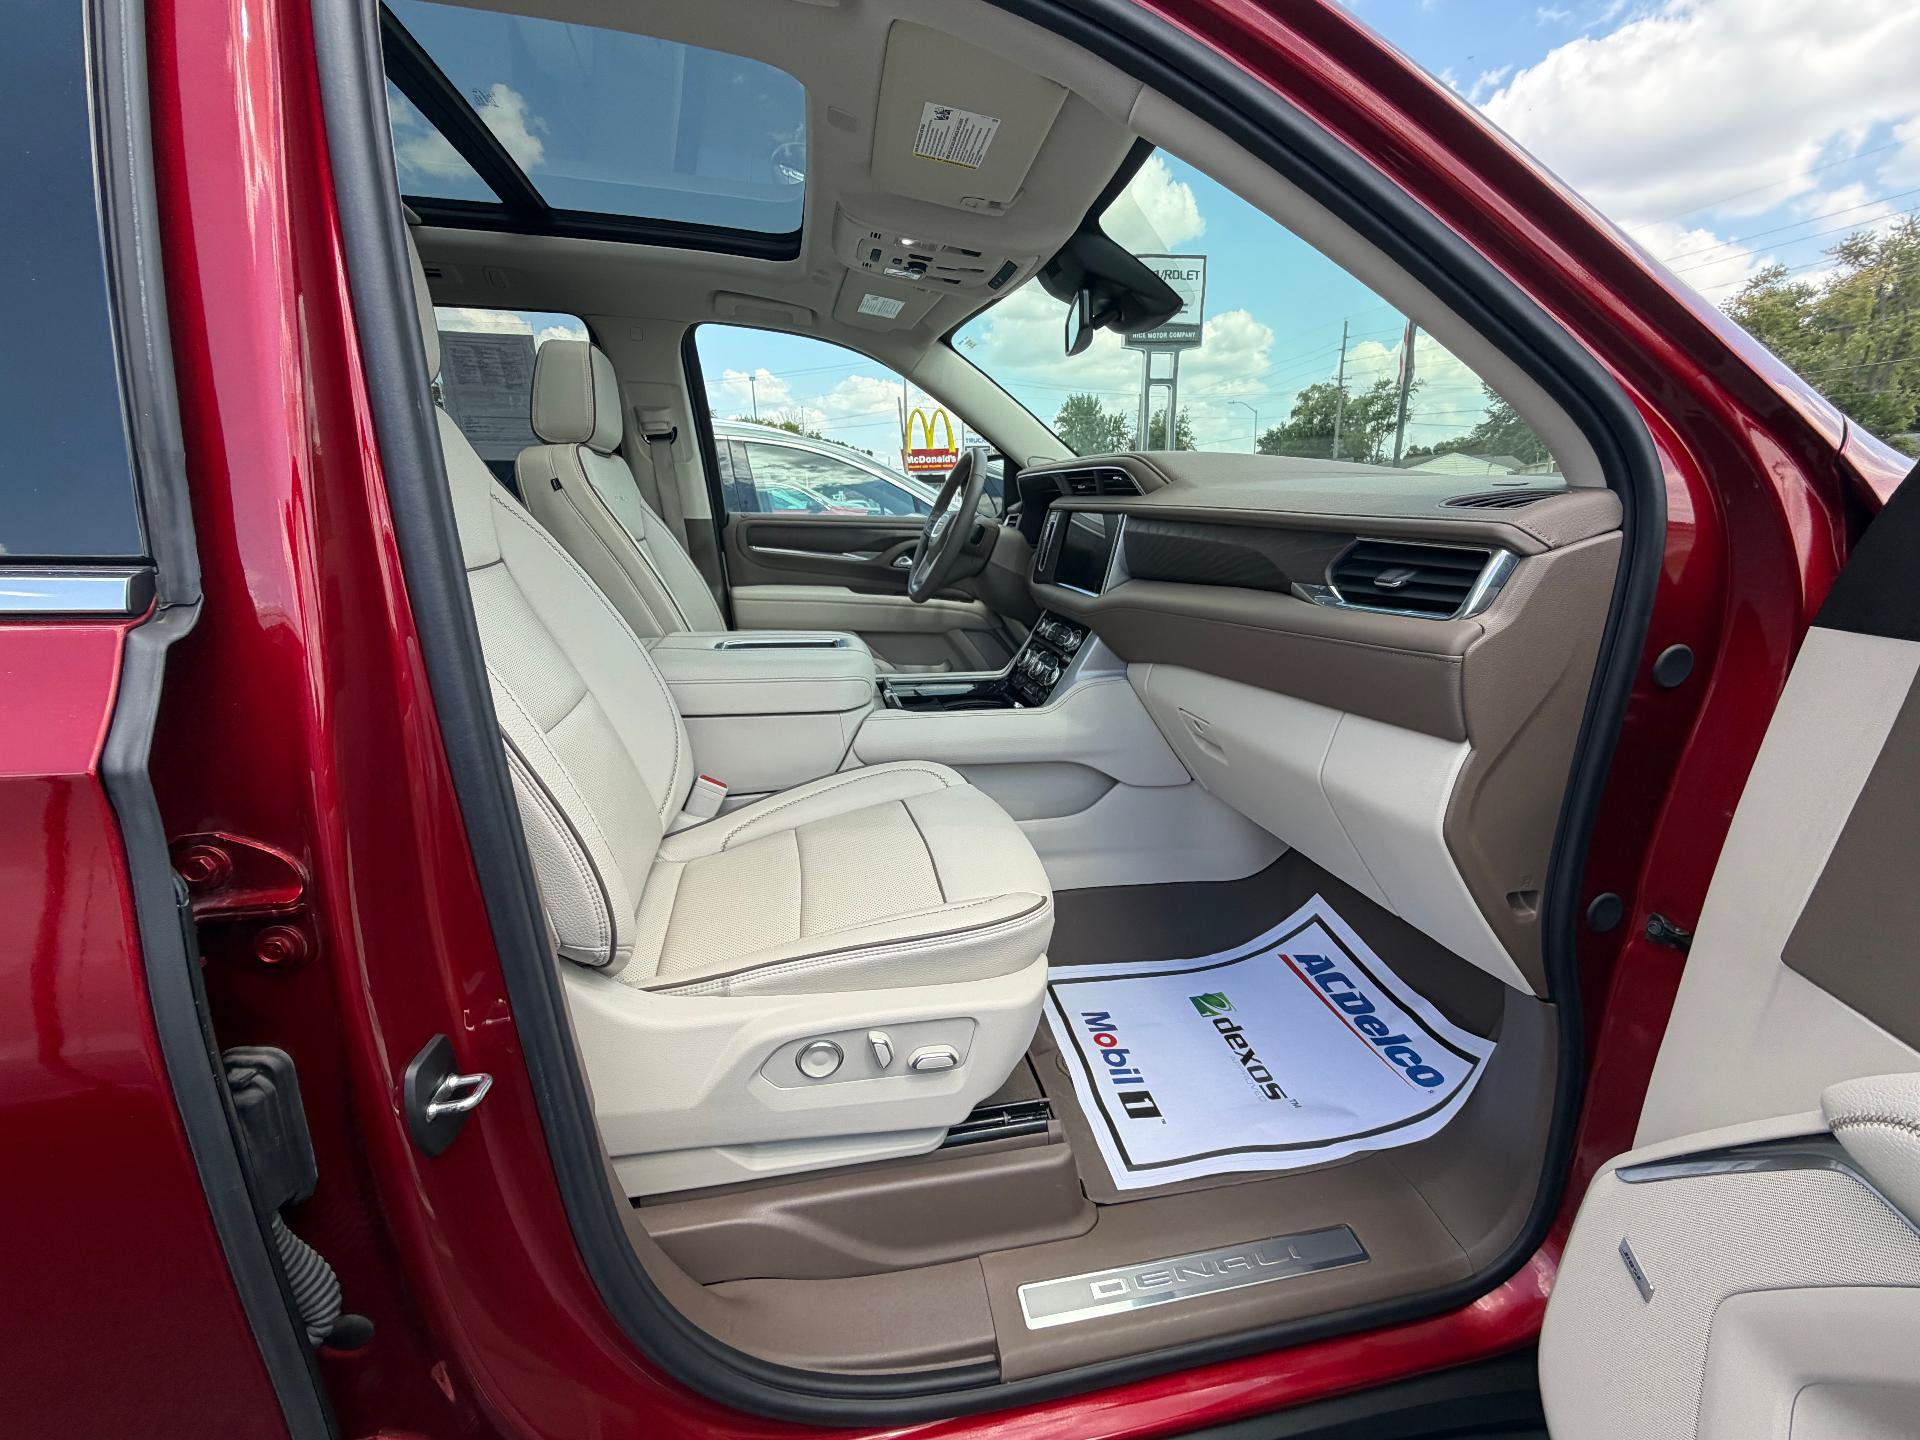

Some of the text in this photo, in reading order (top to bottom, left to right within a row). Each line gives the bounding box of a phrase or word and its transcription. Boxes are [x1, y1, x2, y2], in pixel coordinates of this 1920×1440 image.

[1154, 269, 1200, 281] VROLET
[1168, 331, 1196, 339] COMPANY
[907, 455, 957, 464] McDonald's
[1081, 1011, 1145, 1085] Mobil
[1293, 954, 1445, 1088] ACDelco
[1212, 1017, 1288, 1100] dexos
[1091, 1244, 1301, 1300] DENALI
